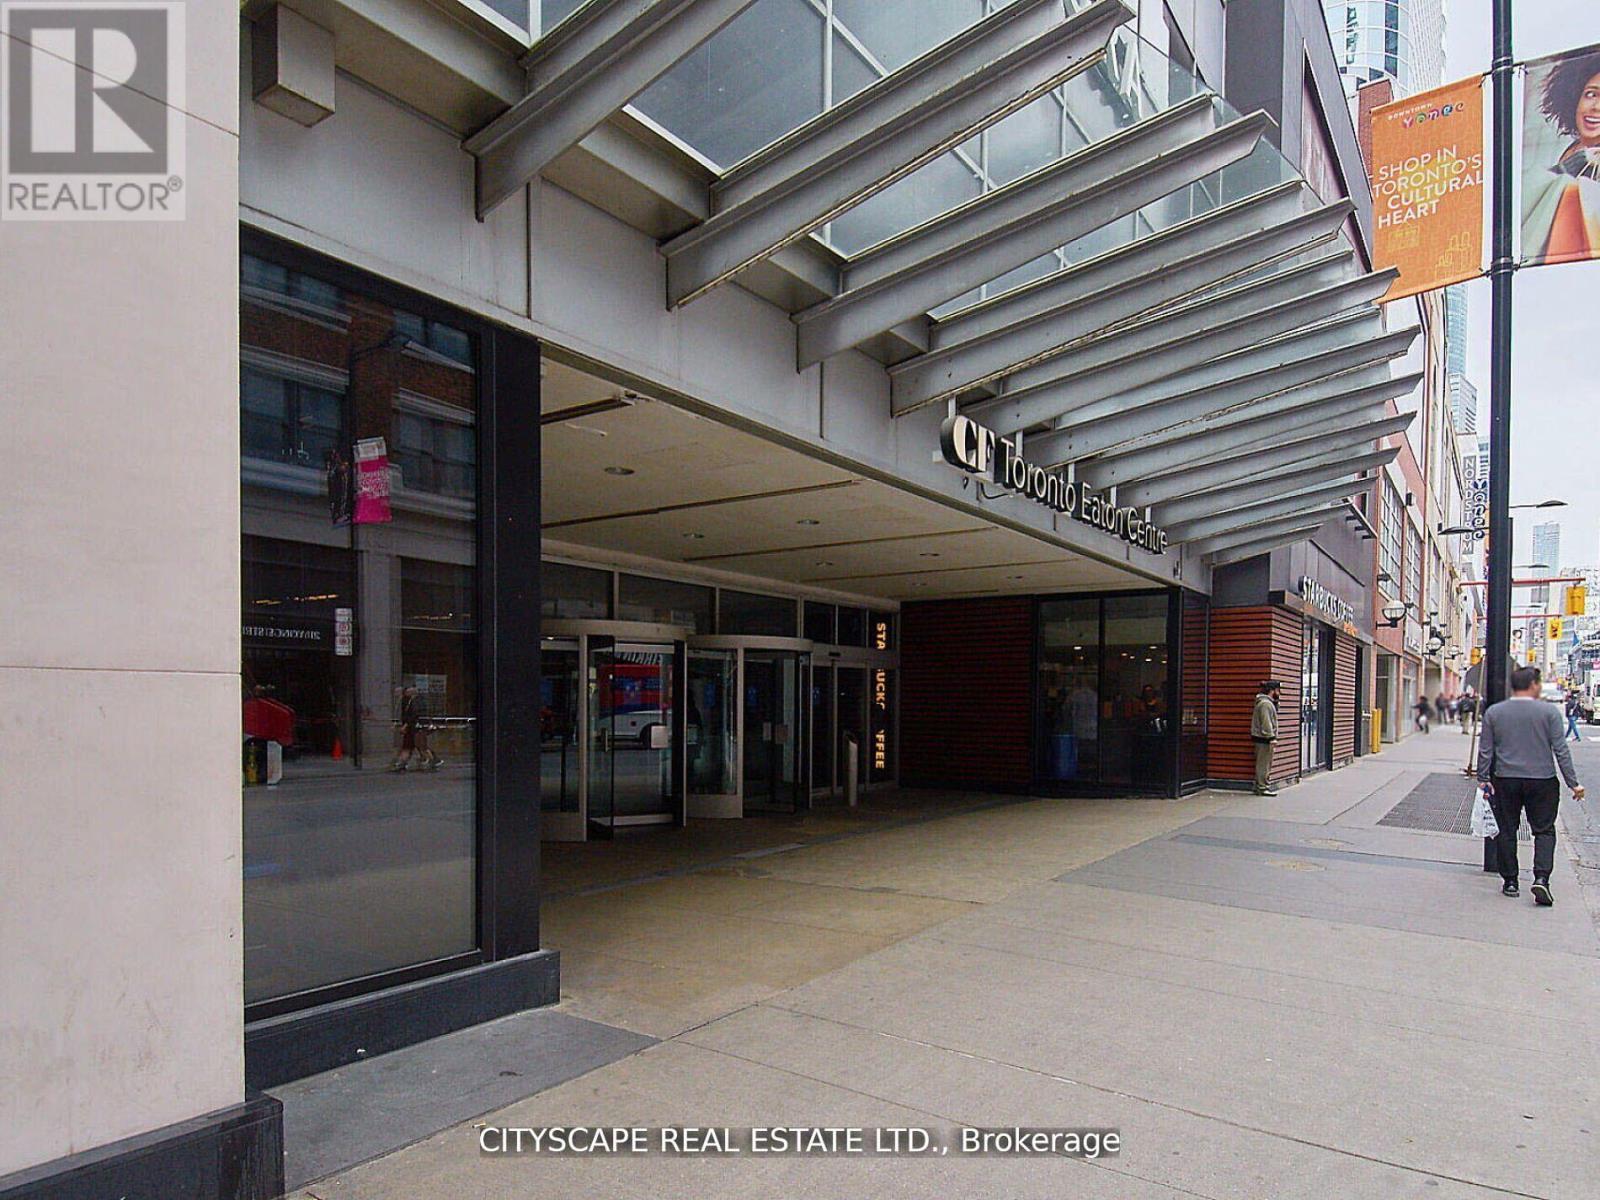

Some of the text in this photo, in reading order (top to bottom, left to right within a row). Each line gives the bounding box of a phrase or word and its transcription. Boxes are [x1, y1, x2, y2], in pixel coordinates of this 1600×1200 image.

[1372, 153, 1482, 198] TORONTO'S
[1379, 144, 1457, 181] SHOP IN
[1387, 170, 1484, 210] CULTURAL
[1378, 199, 1440, 230] HEART
[948, 415, 1168, 555] CF Toronto Eaton Centre
